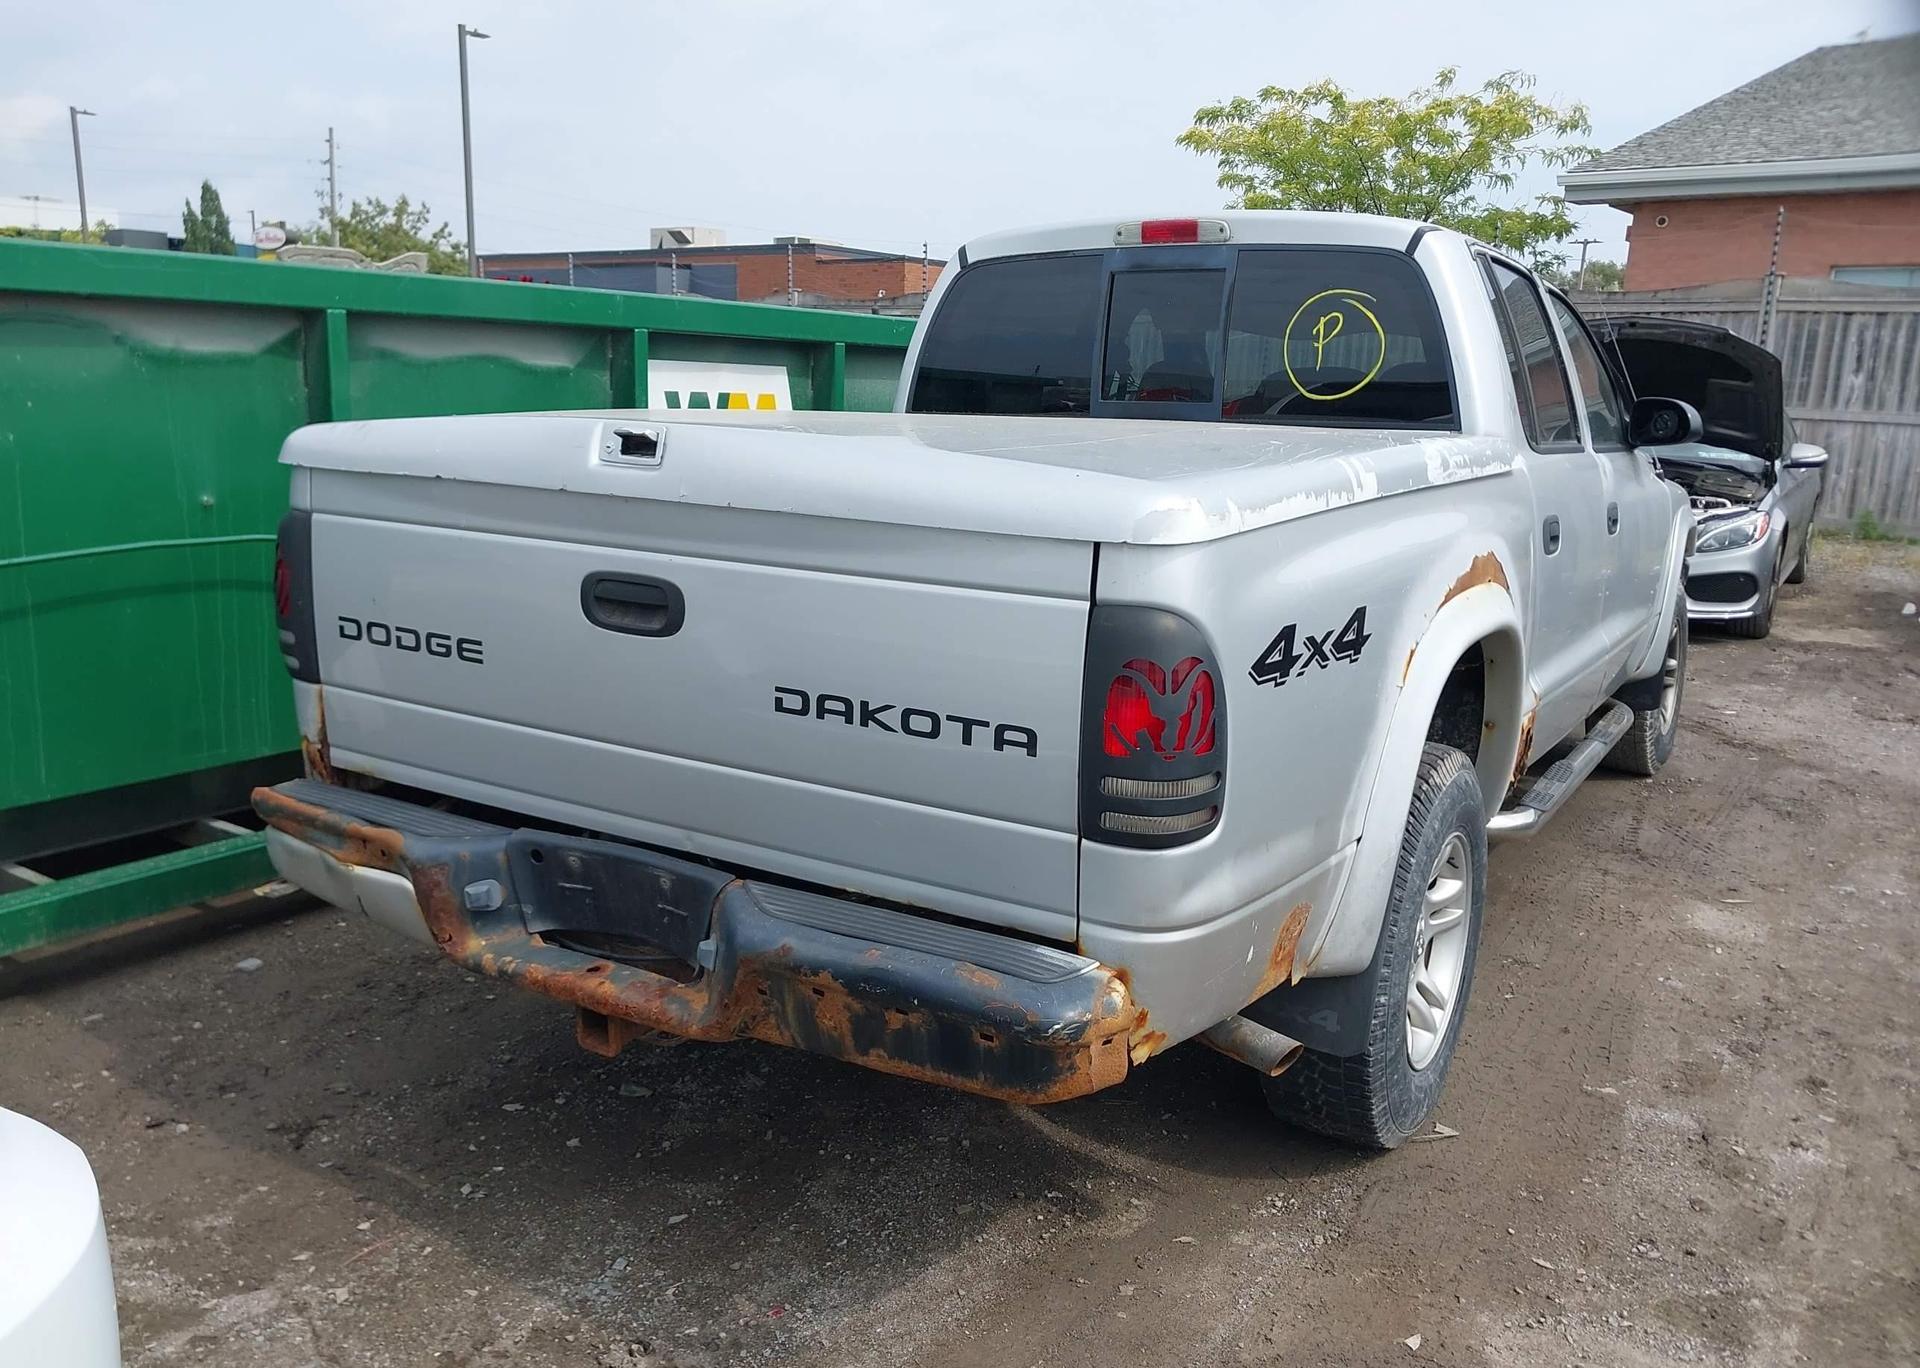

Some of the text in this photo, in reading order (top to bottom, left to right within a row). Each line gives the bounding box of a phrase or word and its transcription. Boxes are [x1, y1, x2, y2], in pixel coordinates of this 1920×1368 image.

[1312, 311, 1344, 372] P
[338, 615, 484, 665] DODGE
[774, 685, 1038, 758] DAKOTA
